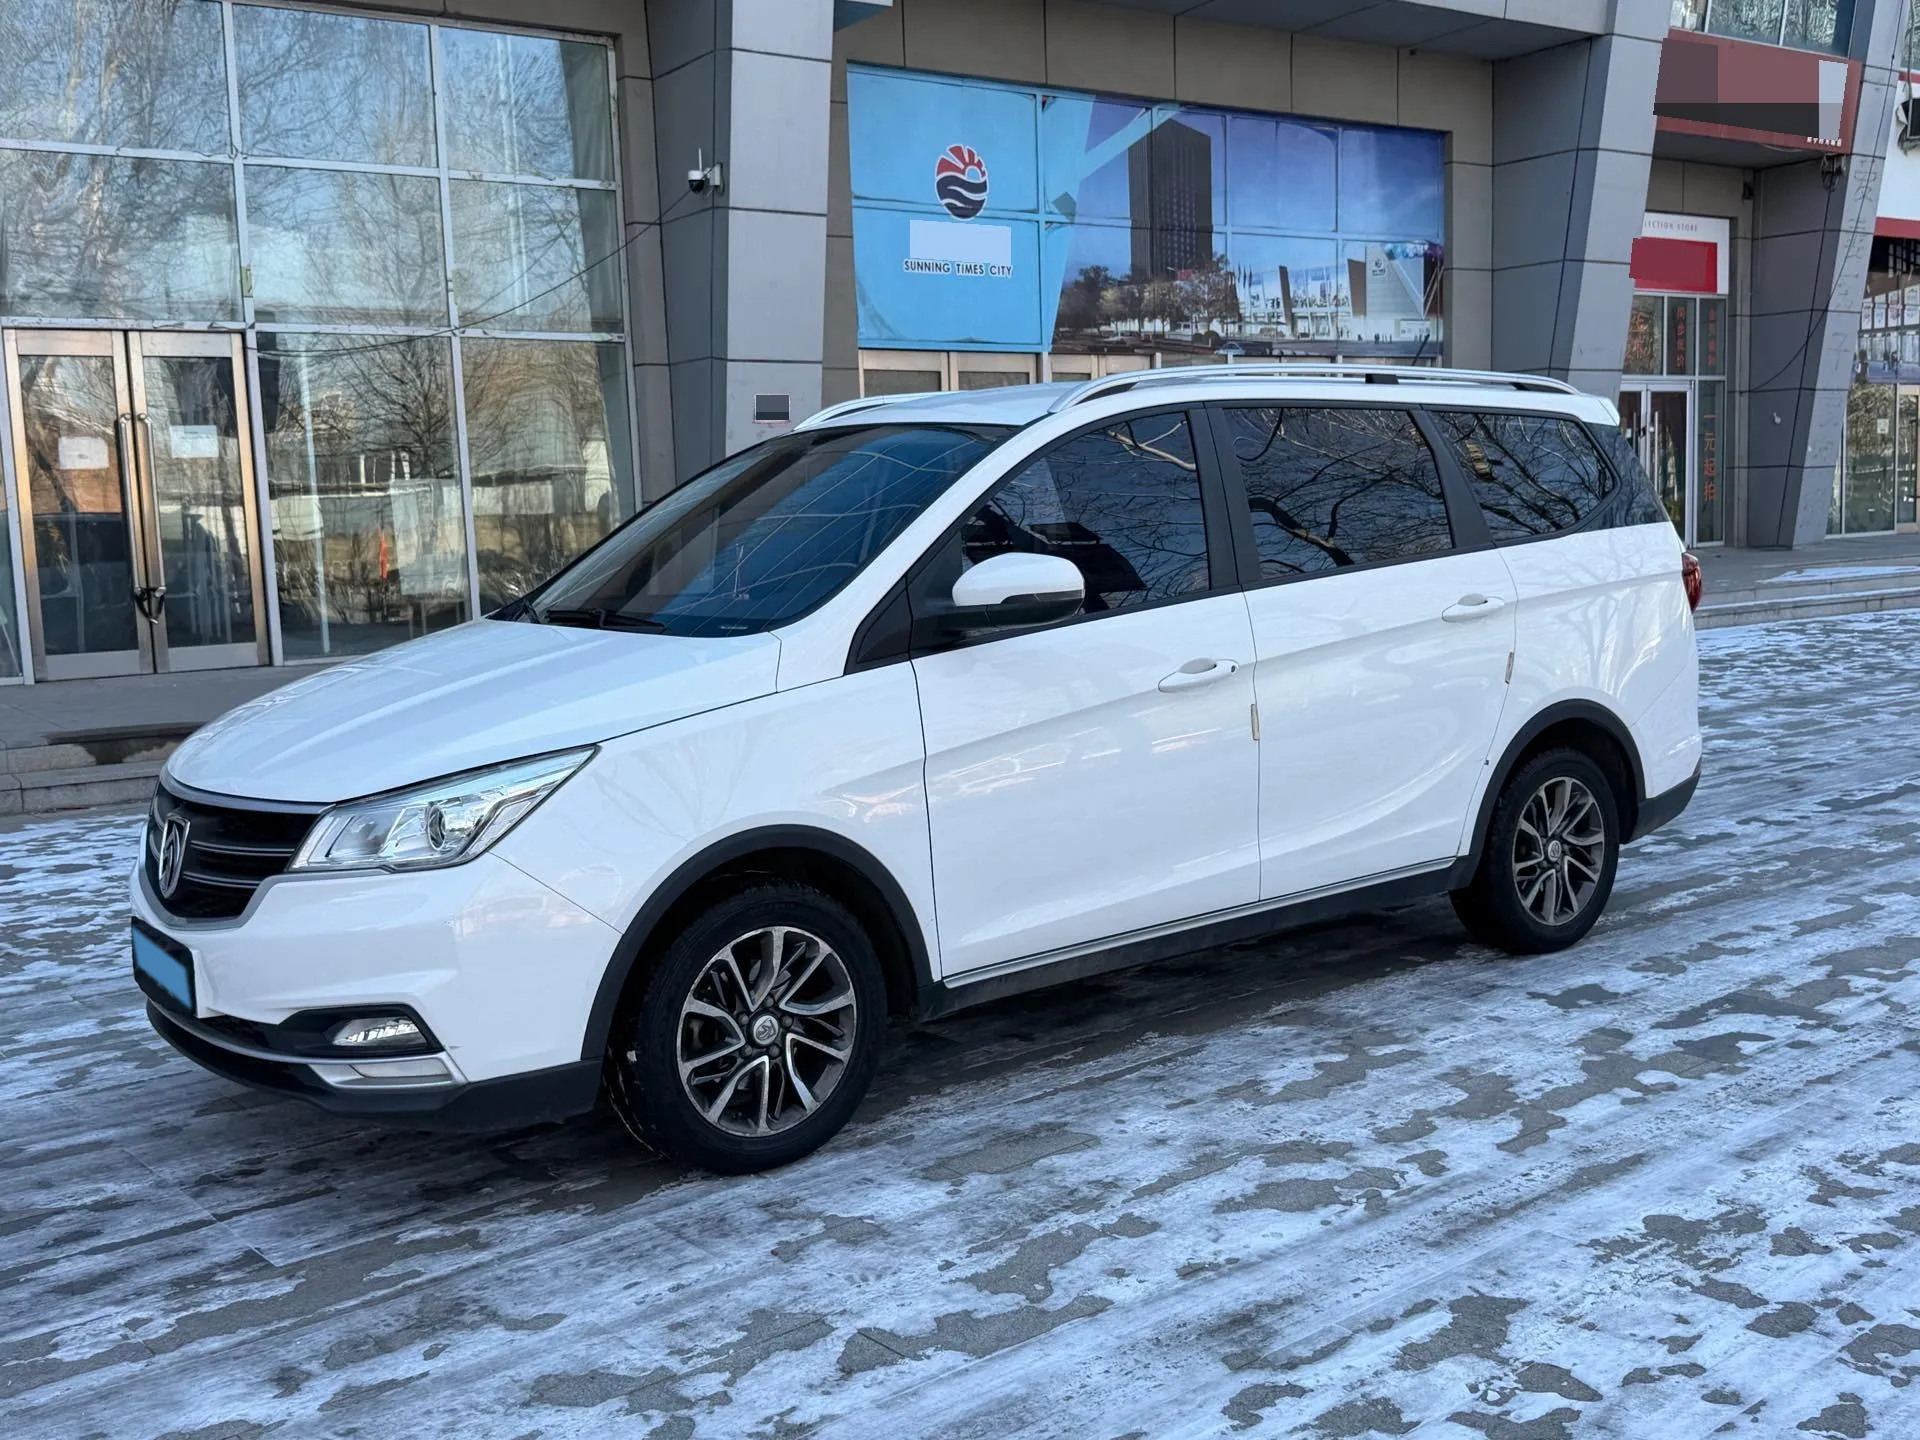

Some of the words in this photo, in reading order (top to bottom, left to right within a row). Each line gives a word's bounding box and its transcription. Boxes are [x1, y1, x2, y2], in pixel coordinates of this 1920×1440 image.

[904, 260, 951, 273] SUNNING
[956, 263, 984, 275] TIMES
[989, 265, 1012, 276] CITY
